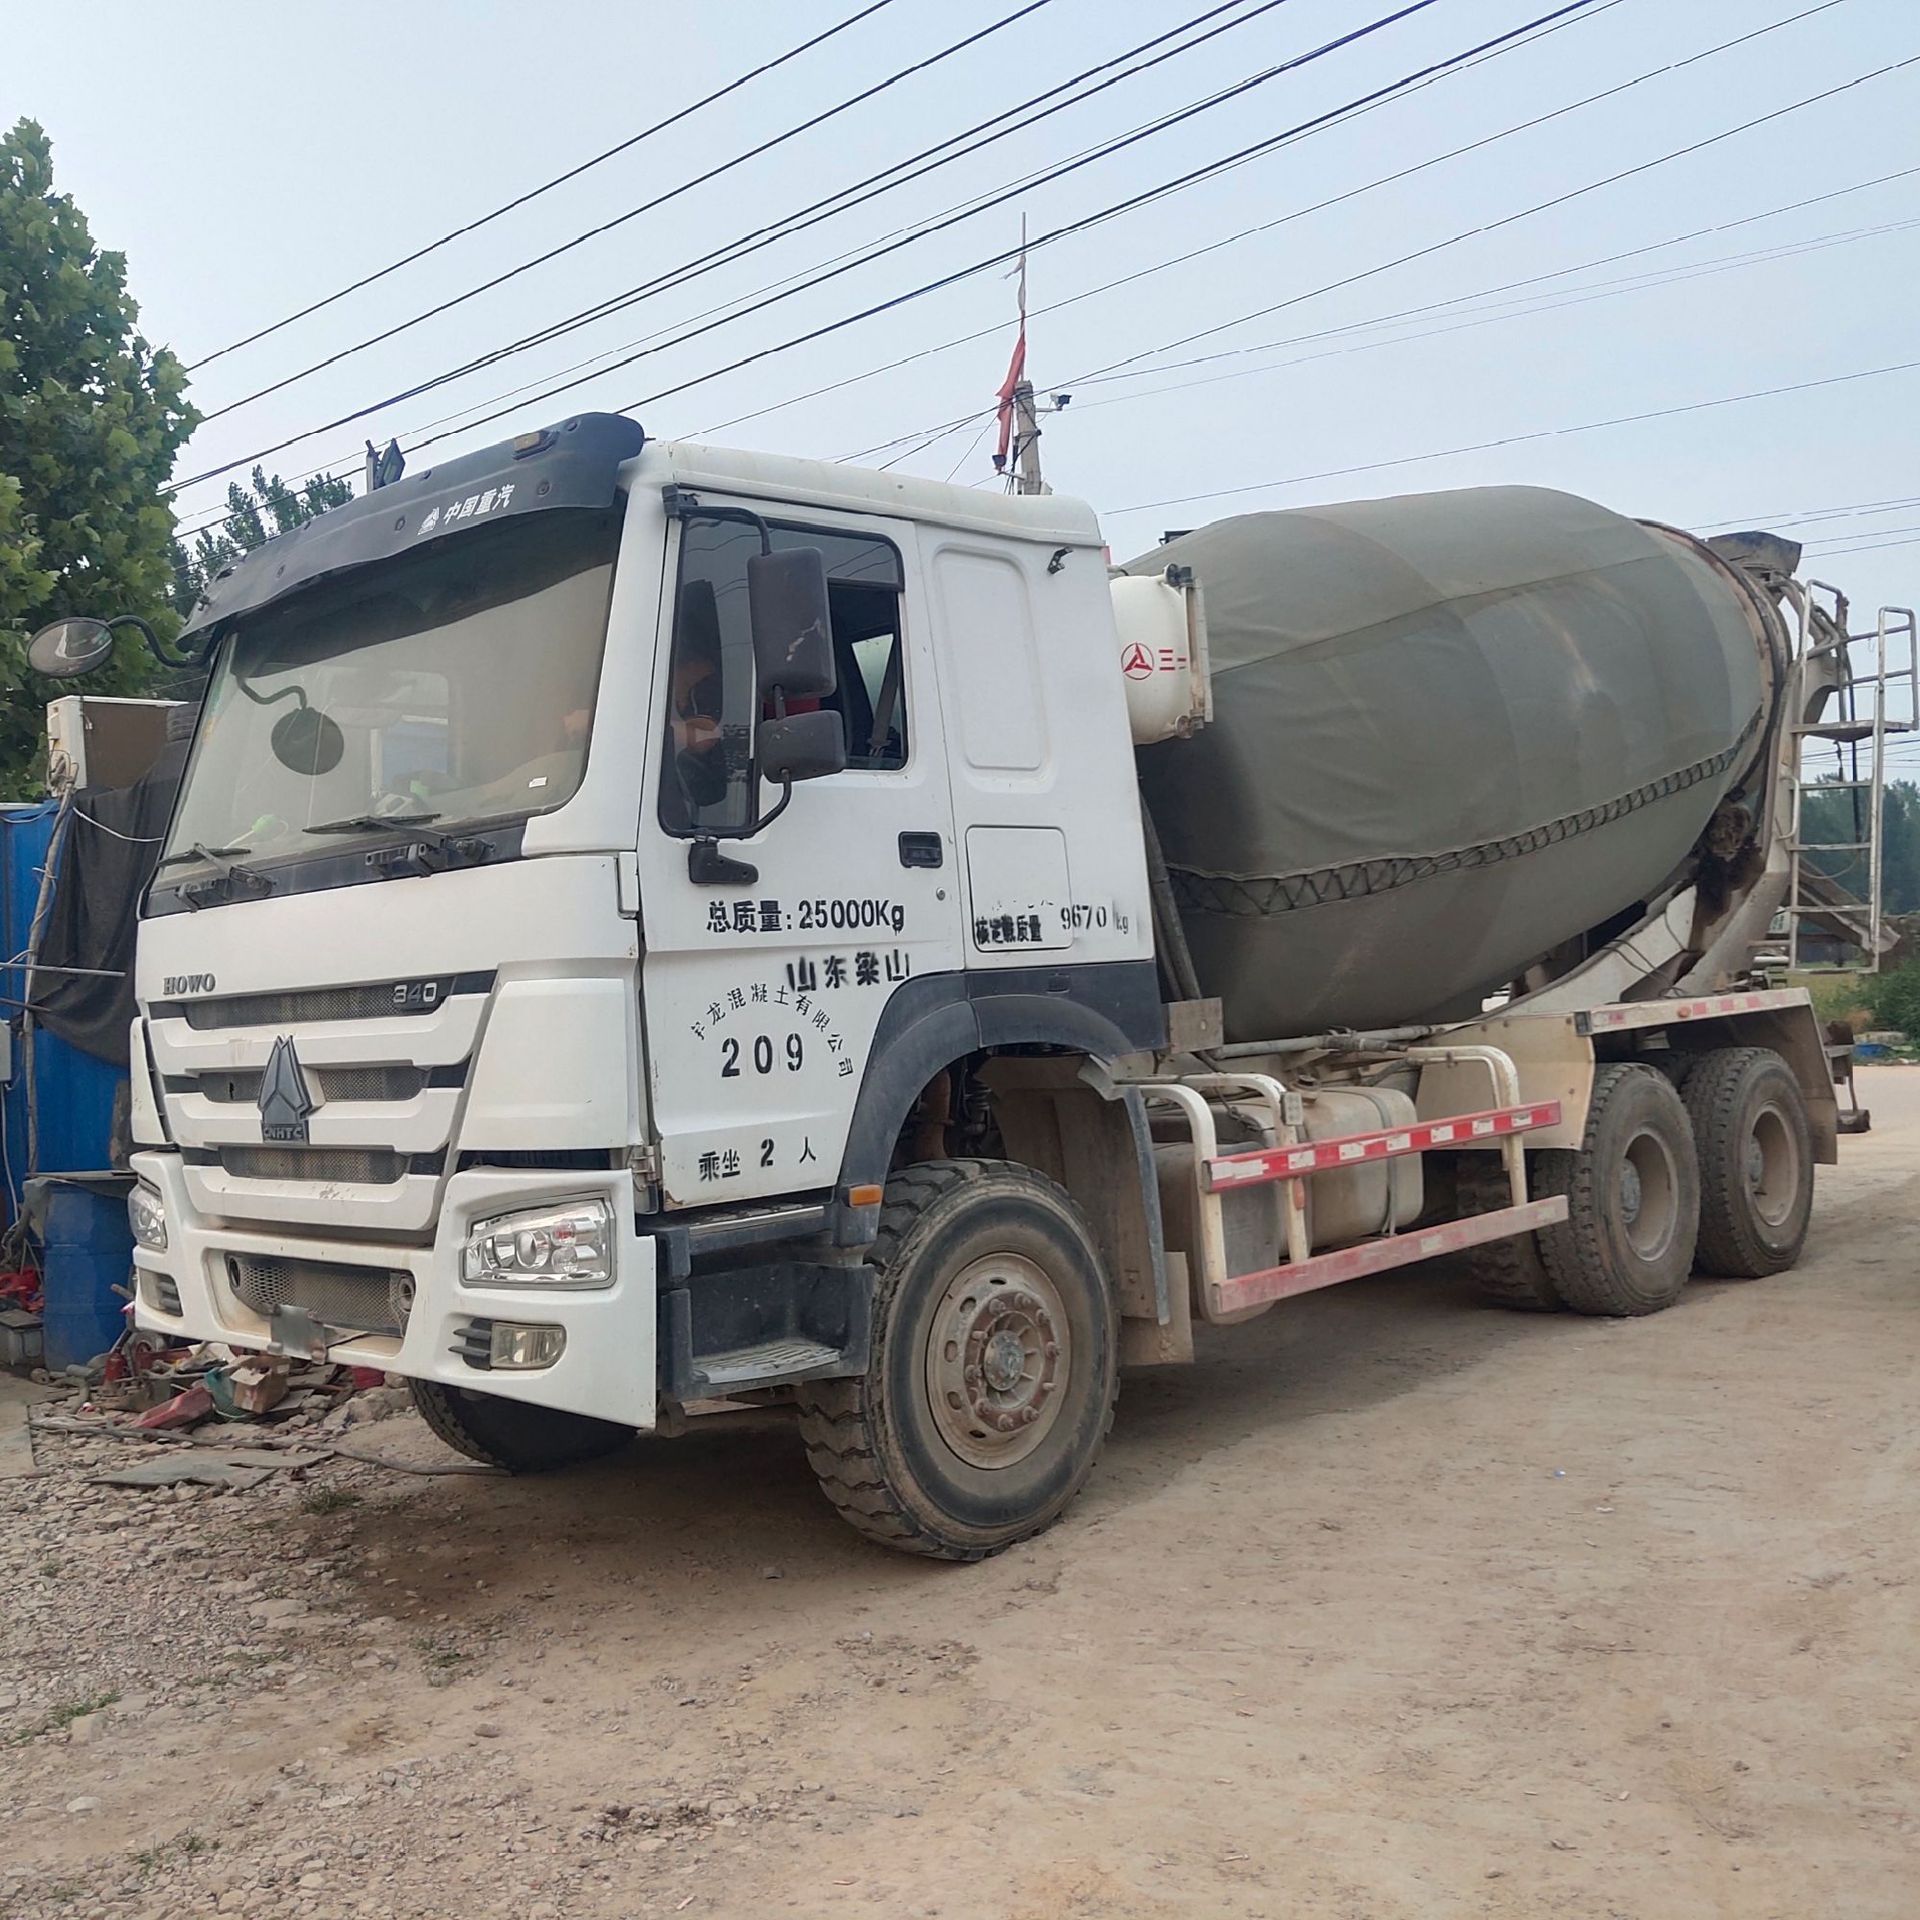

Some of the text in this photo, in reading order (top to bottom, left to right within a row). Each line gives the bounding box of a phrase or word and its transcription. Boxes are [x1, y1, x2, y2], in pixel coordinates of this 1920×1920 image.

[443, 484, 515, 525] 中国重汽
[1061, 904, 1106, 930] 9670
[163, 973, 216, 995] HOWO
[786, 949, 909, 992] 山东梁山
[721, 1033, 803, 1078] 209
